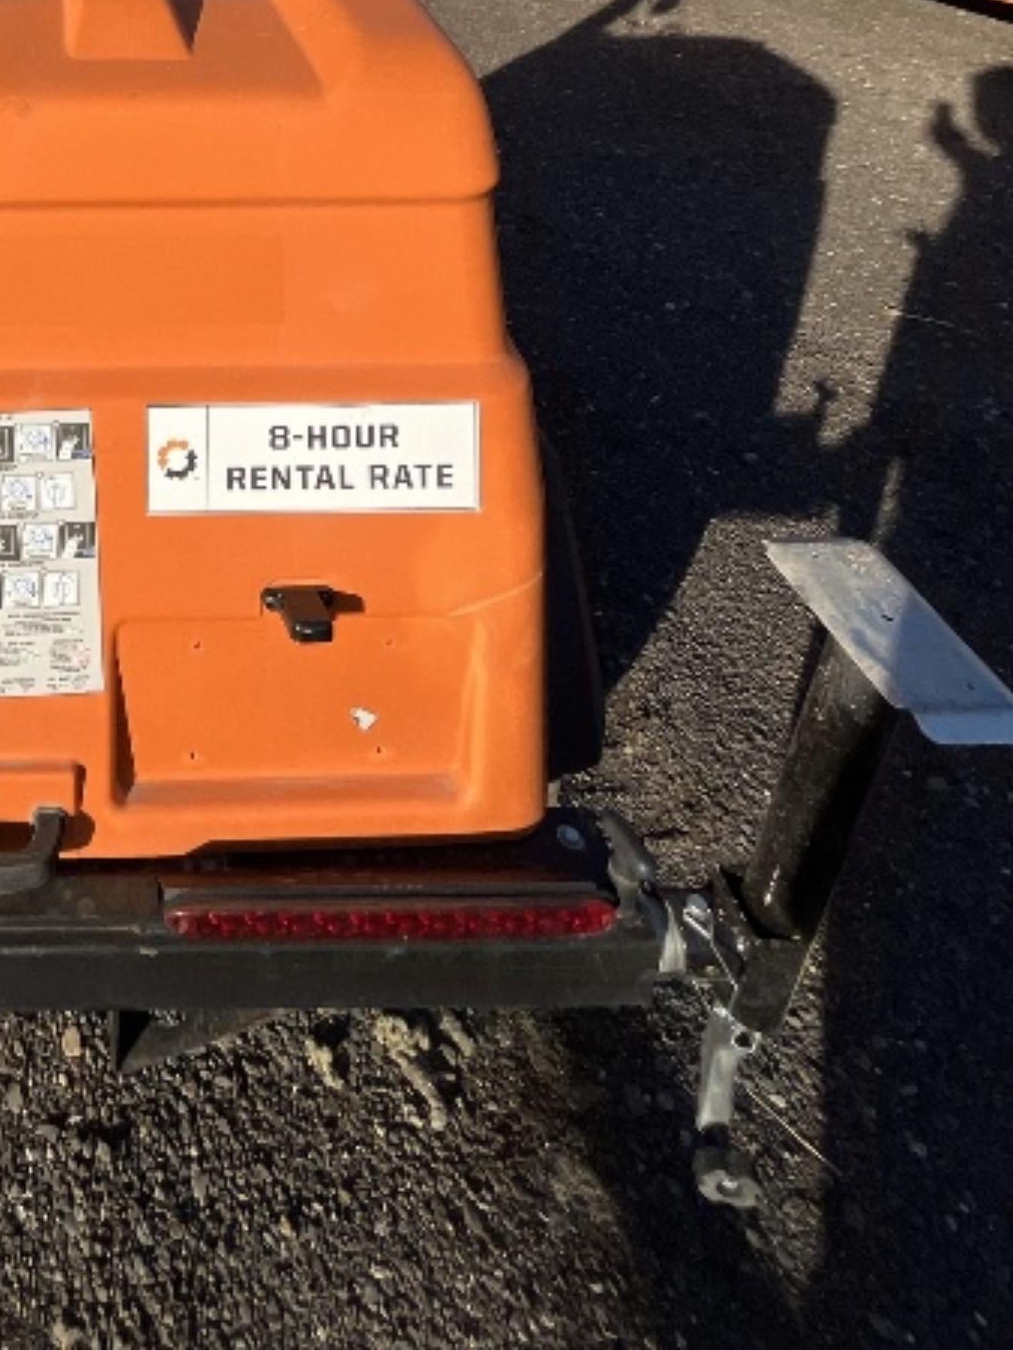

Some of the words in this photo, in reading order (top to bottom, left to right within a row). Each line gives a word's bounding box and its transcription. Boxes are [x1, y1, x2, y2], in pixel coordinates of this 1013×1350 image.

[269, 424, 399, 450] 8-HOUR
[226, 463, 355, 490] RENTAL
[369, 463, 454, 489] RATE
